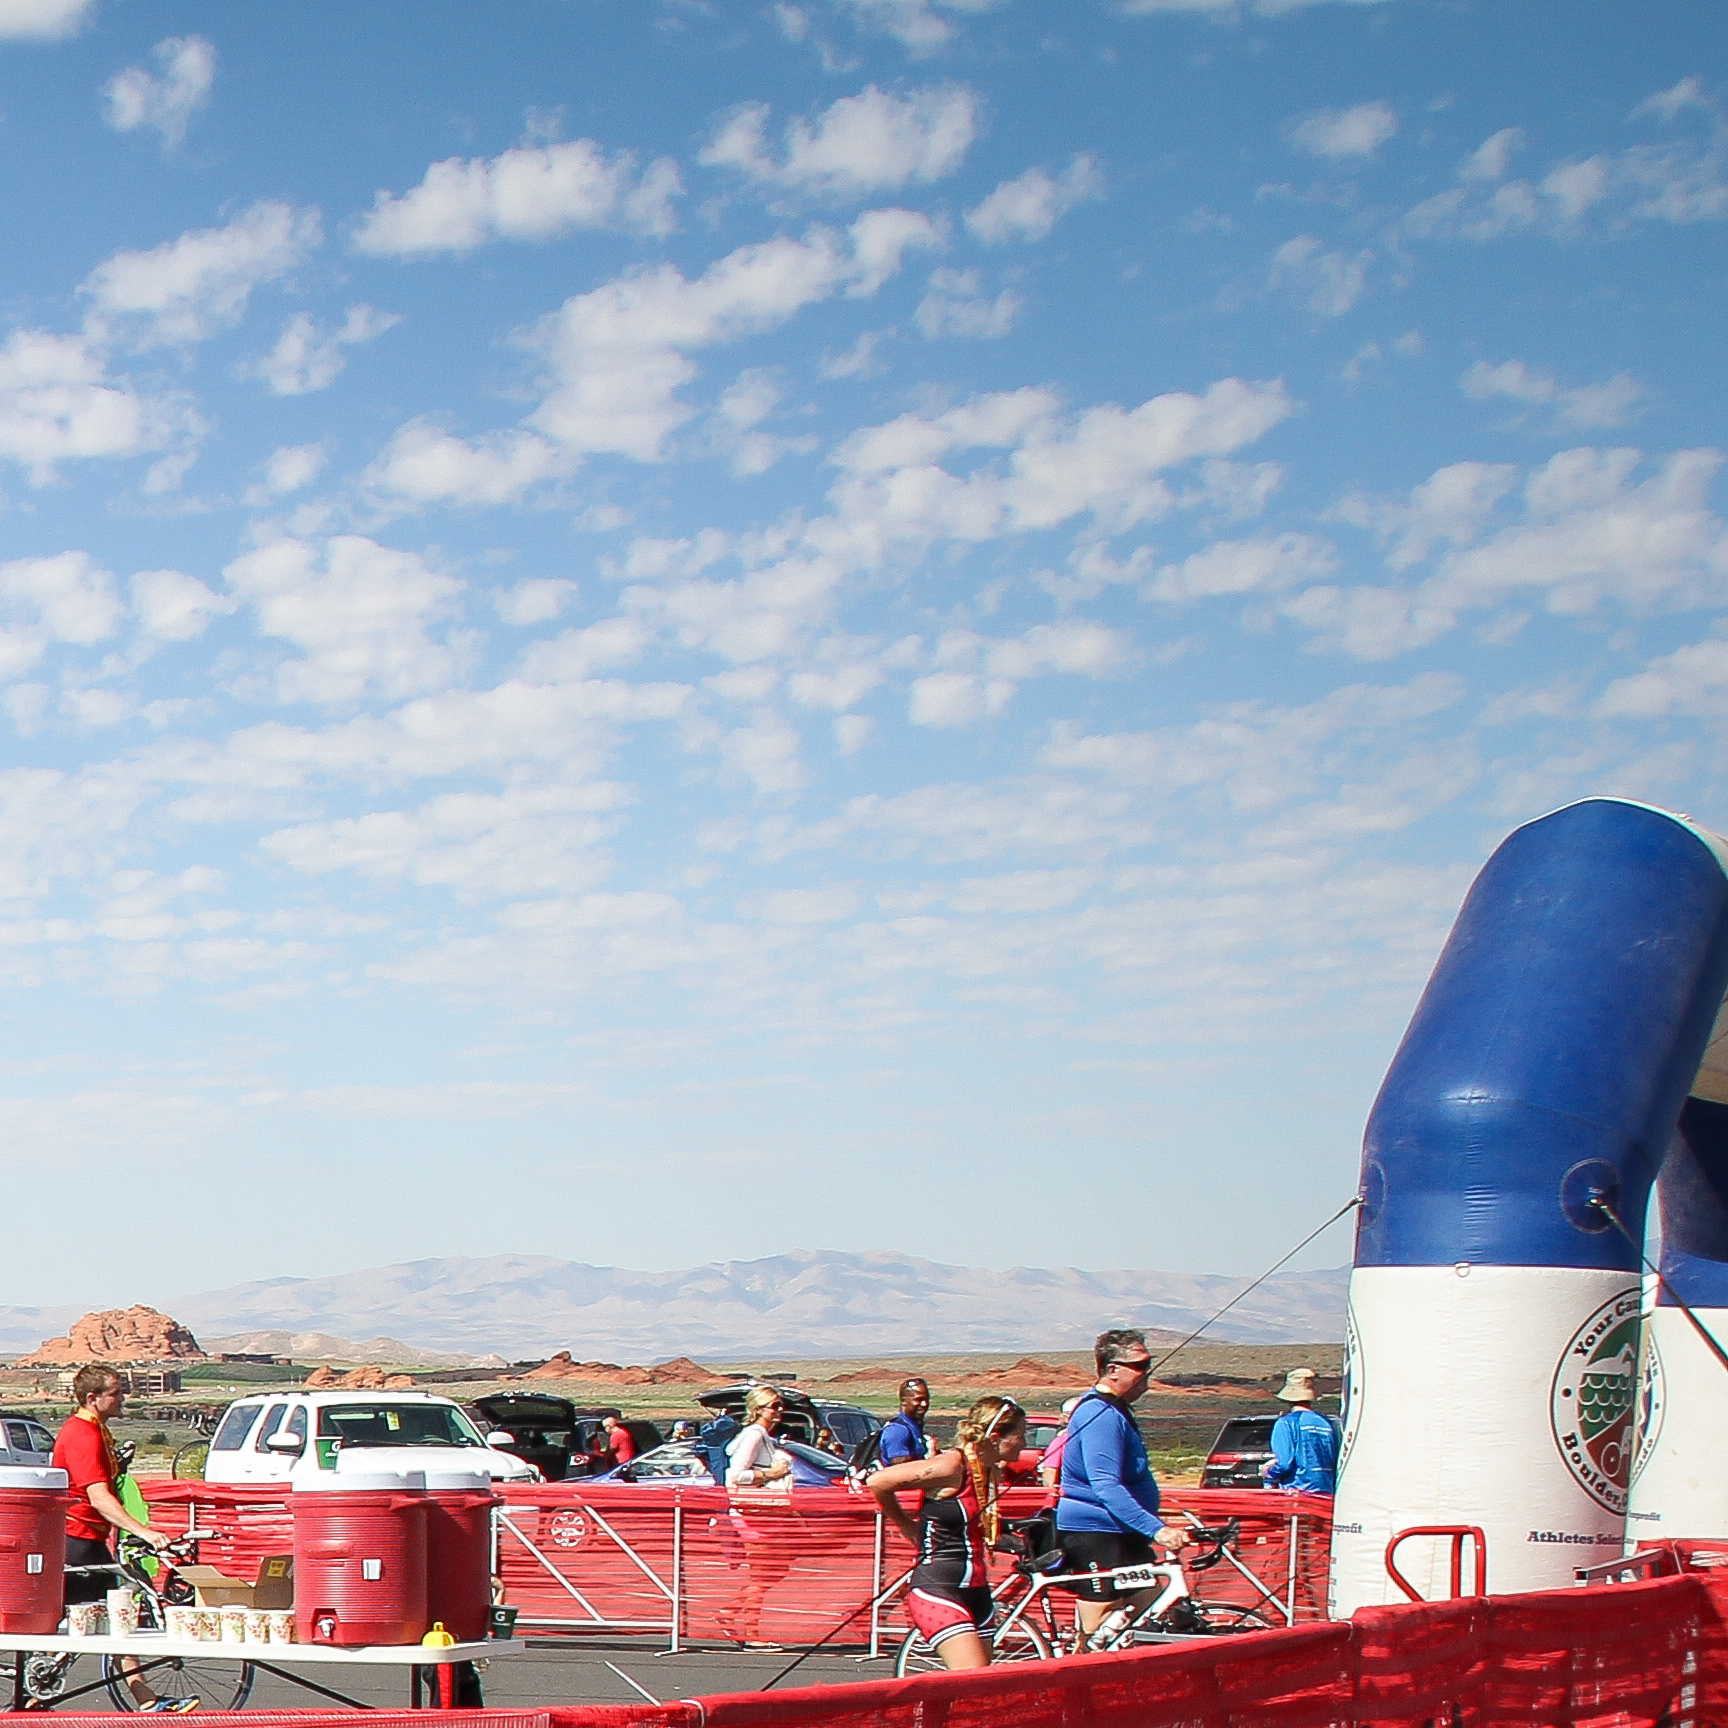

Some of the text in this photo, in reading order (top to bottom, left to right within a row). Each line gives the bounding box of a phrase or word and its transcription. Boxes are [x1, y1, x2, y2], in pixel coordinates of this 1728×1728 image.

[1573, 1314, 1613, 1356] Your
[1527, 1531, 1594, 1544] Athletes
[495, 1611, 505, 1622] G
